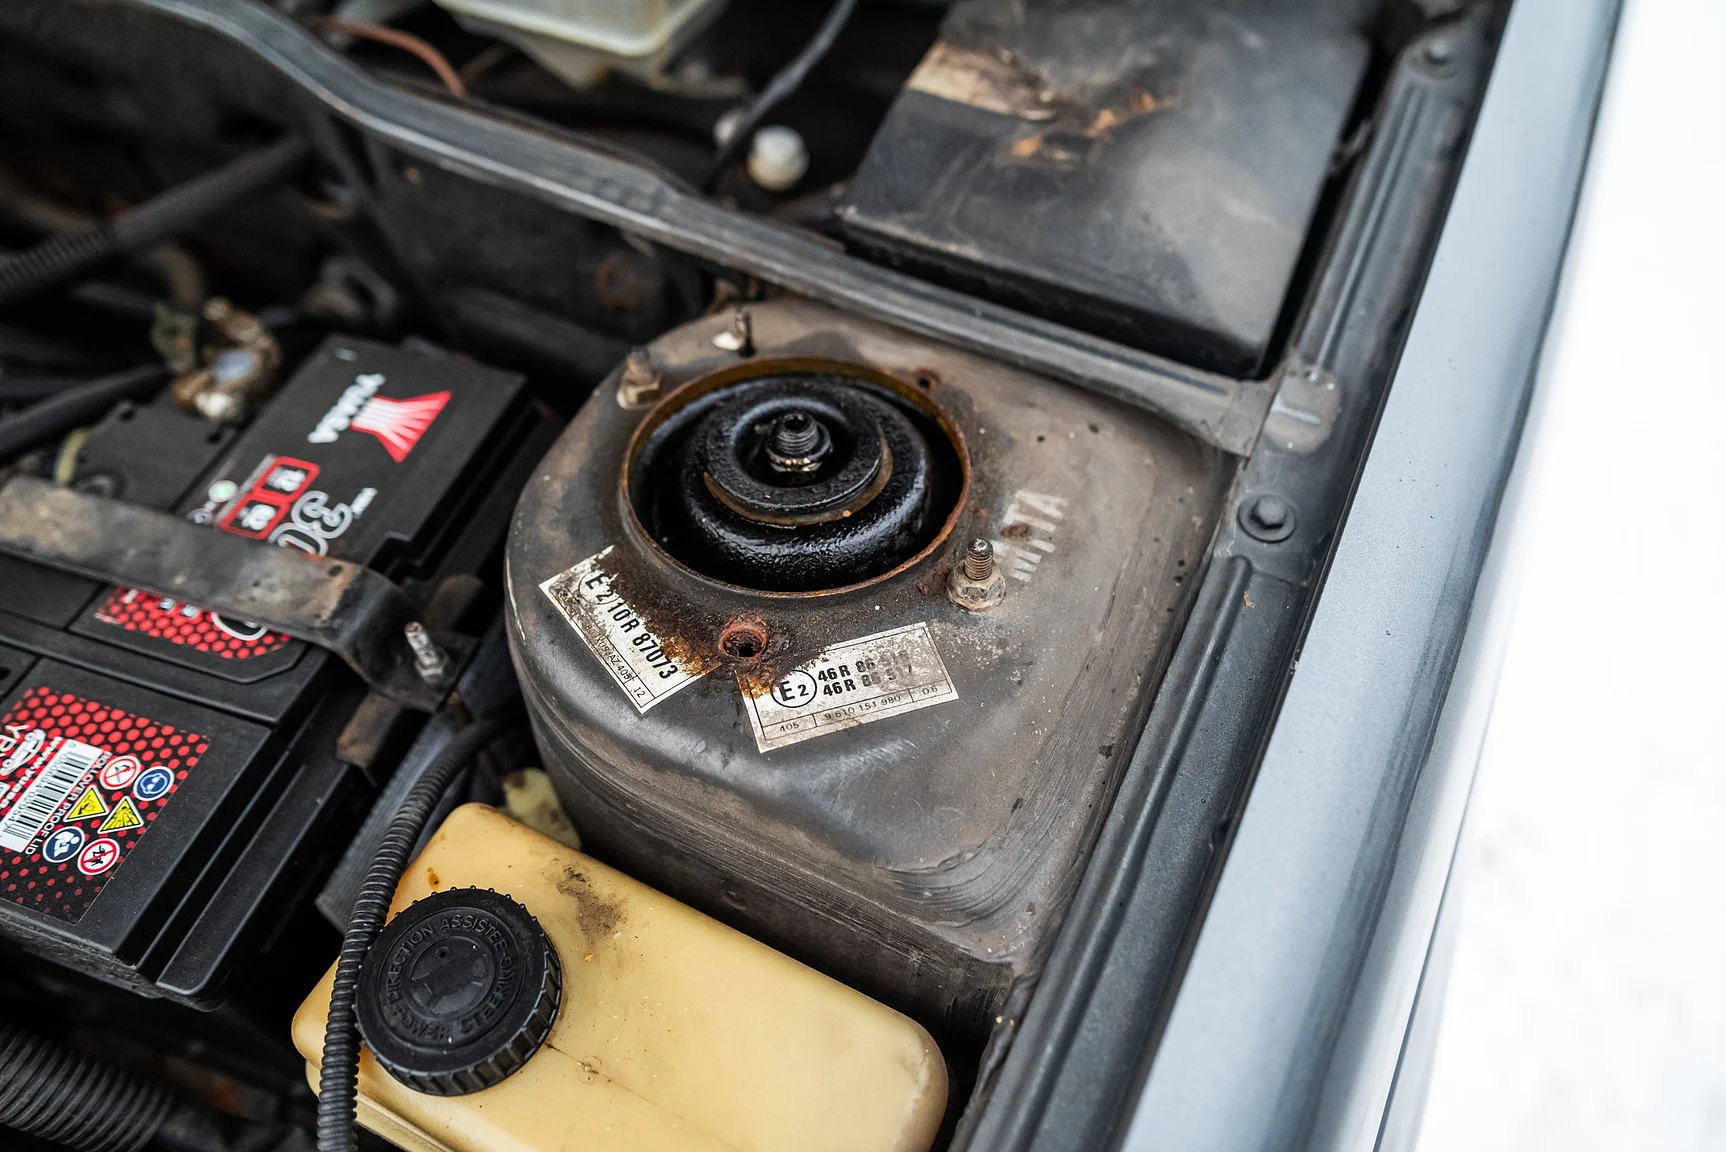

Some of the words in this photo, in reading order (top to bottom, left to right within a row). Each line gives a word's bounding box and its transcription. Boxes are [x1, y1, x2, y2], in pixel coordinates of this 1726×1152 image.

[632, 633, 679, 679] 87073
[633, 686, 645, 697] 12
[779, 721, 800, 732] 405
[881, 696, 901, 707] 980
[67, 751, 113, 800] ROLLOVER
[41, 801, 71, 838] PROOF
[25, 838, 43, 855] LID
[387, 924, 434, 1004] DIRECTION
